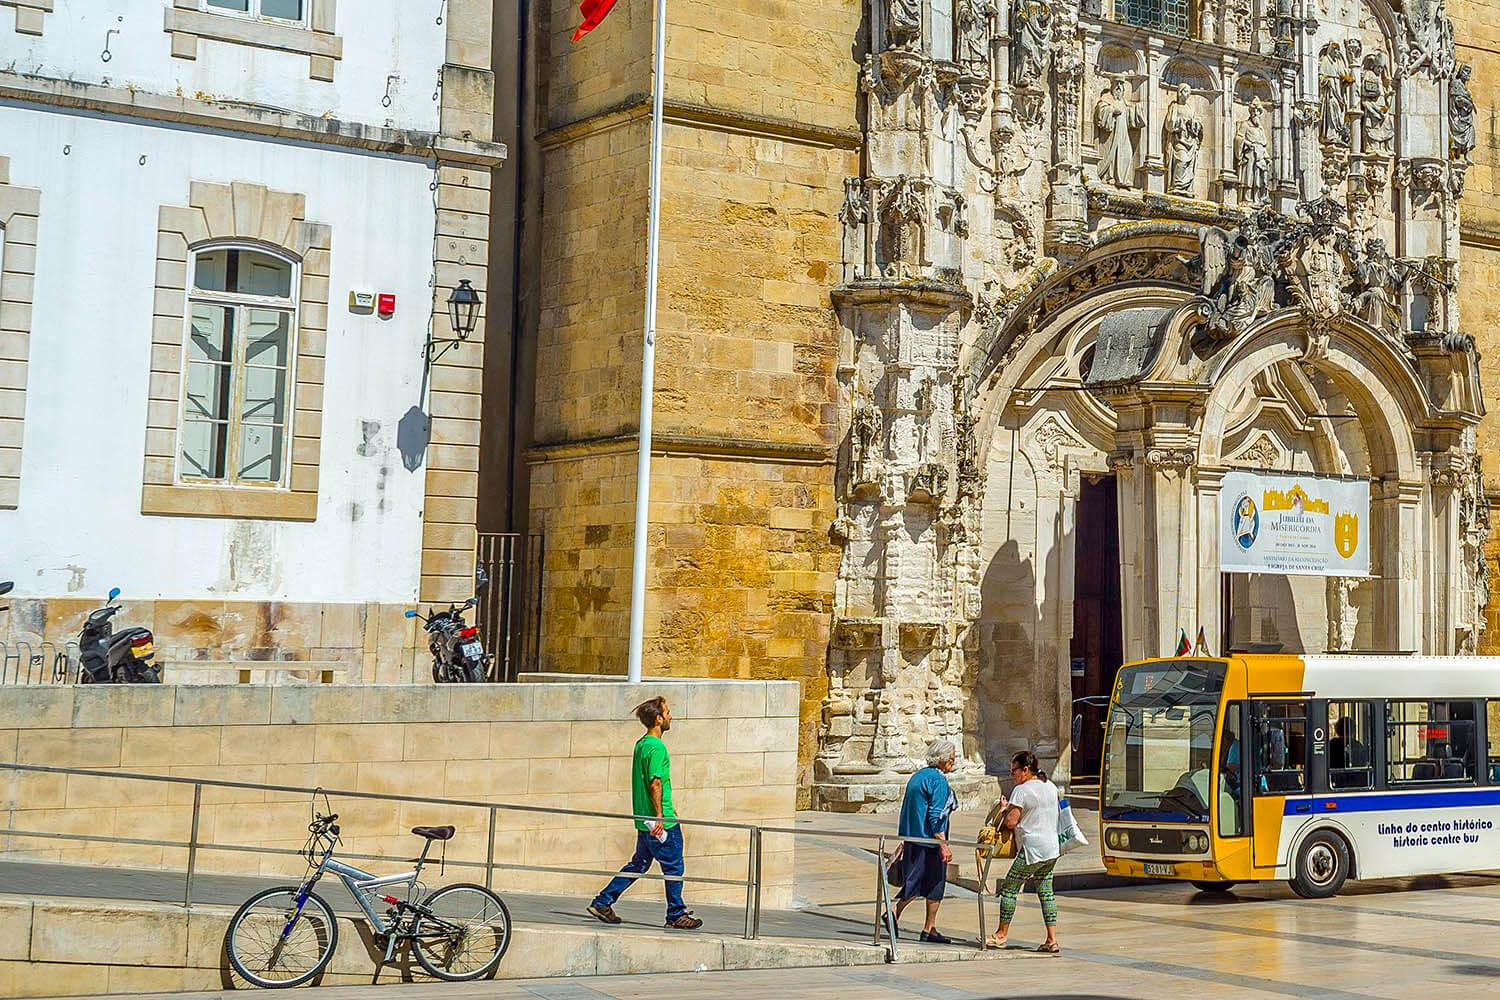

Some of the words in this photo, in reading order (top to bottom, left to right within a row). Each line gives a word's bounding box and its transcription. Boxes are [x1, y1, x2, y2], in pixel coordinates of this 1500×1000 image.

[1405, 821, 1418, 833] do
[1420, 819, 1451, 832] centro
[1453, 818, 1493, 830] histórico
[1393, 835, 1429, 848] historic
[1430, 833, 1461, 845] centre
[1463, 831, 1480, 844] bus
